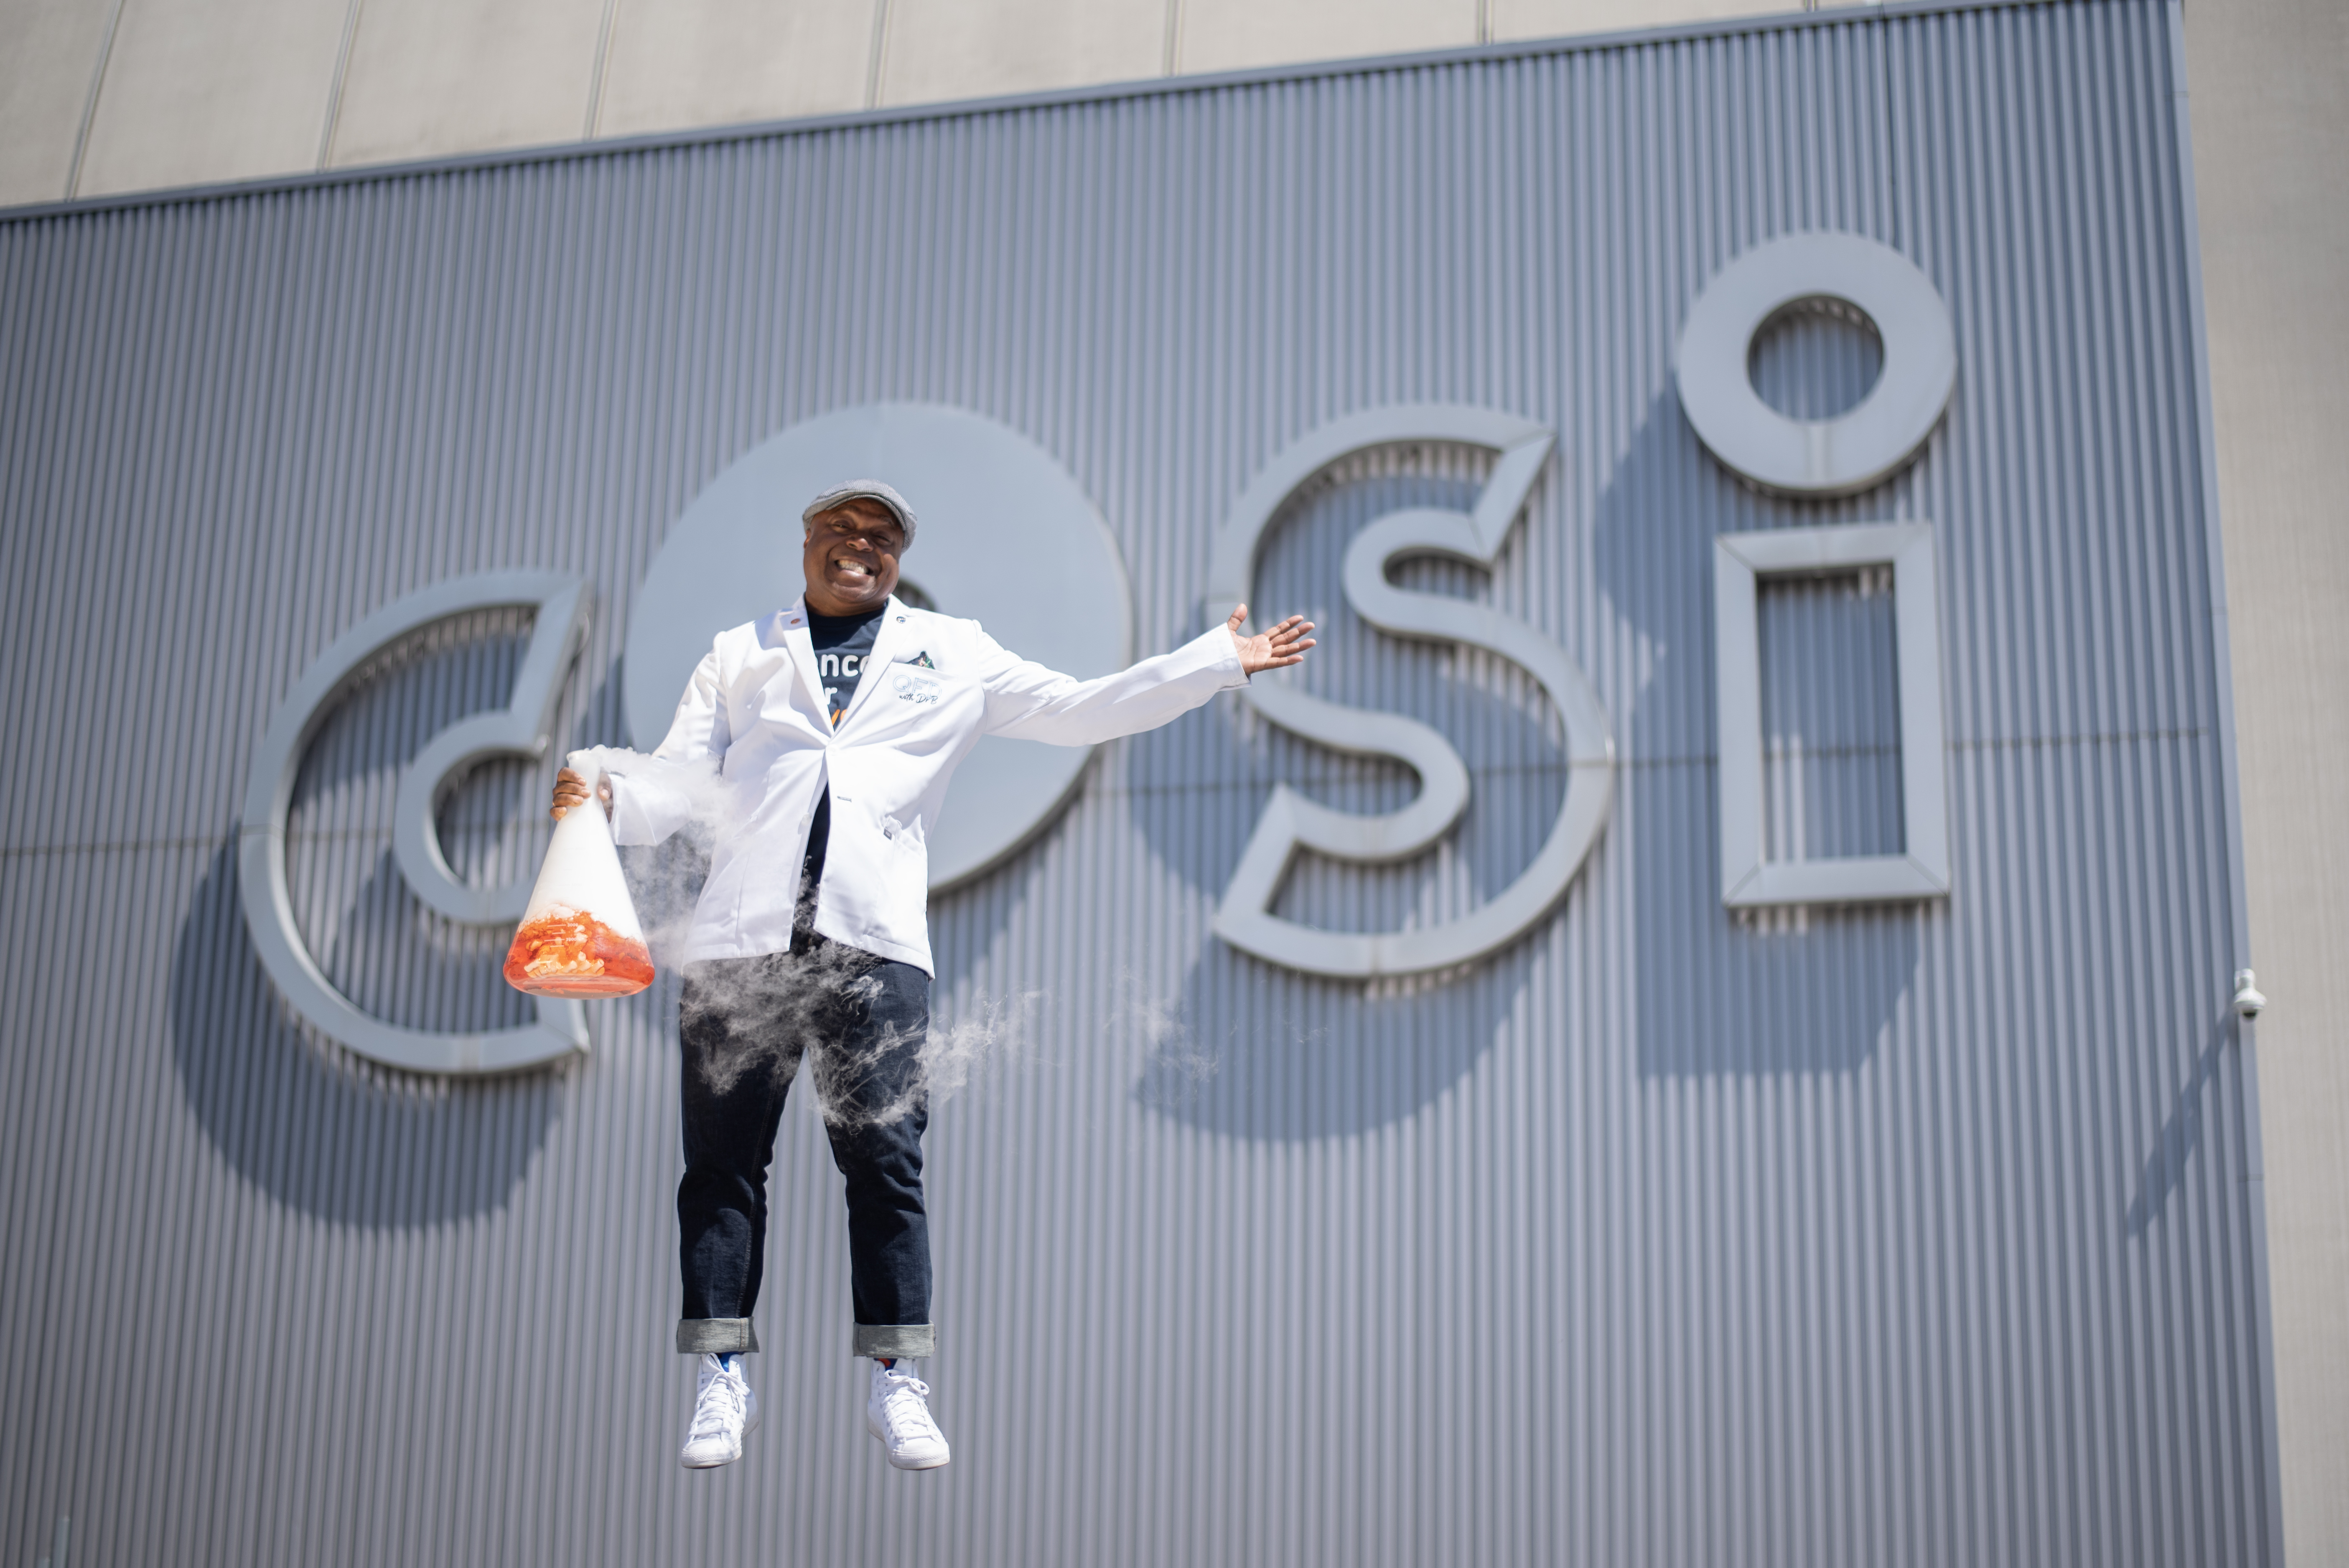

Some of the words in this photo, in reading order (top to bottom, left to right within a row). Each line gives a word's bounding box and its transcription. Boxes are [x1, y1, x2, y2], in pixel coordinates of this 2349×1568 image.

[893, 675, 942, 700] QED
[899, 693, 915, 702] with
[916, 693, 929, 703] Dr
[930, 695, 938, 705] B
